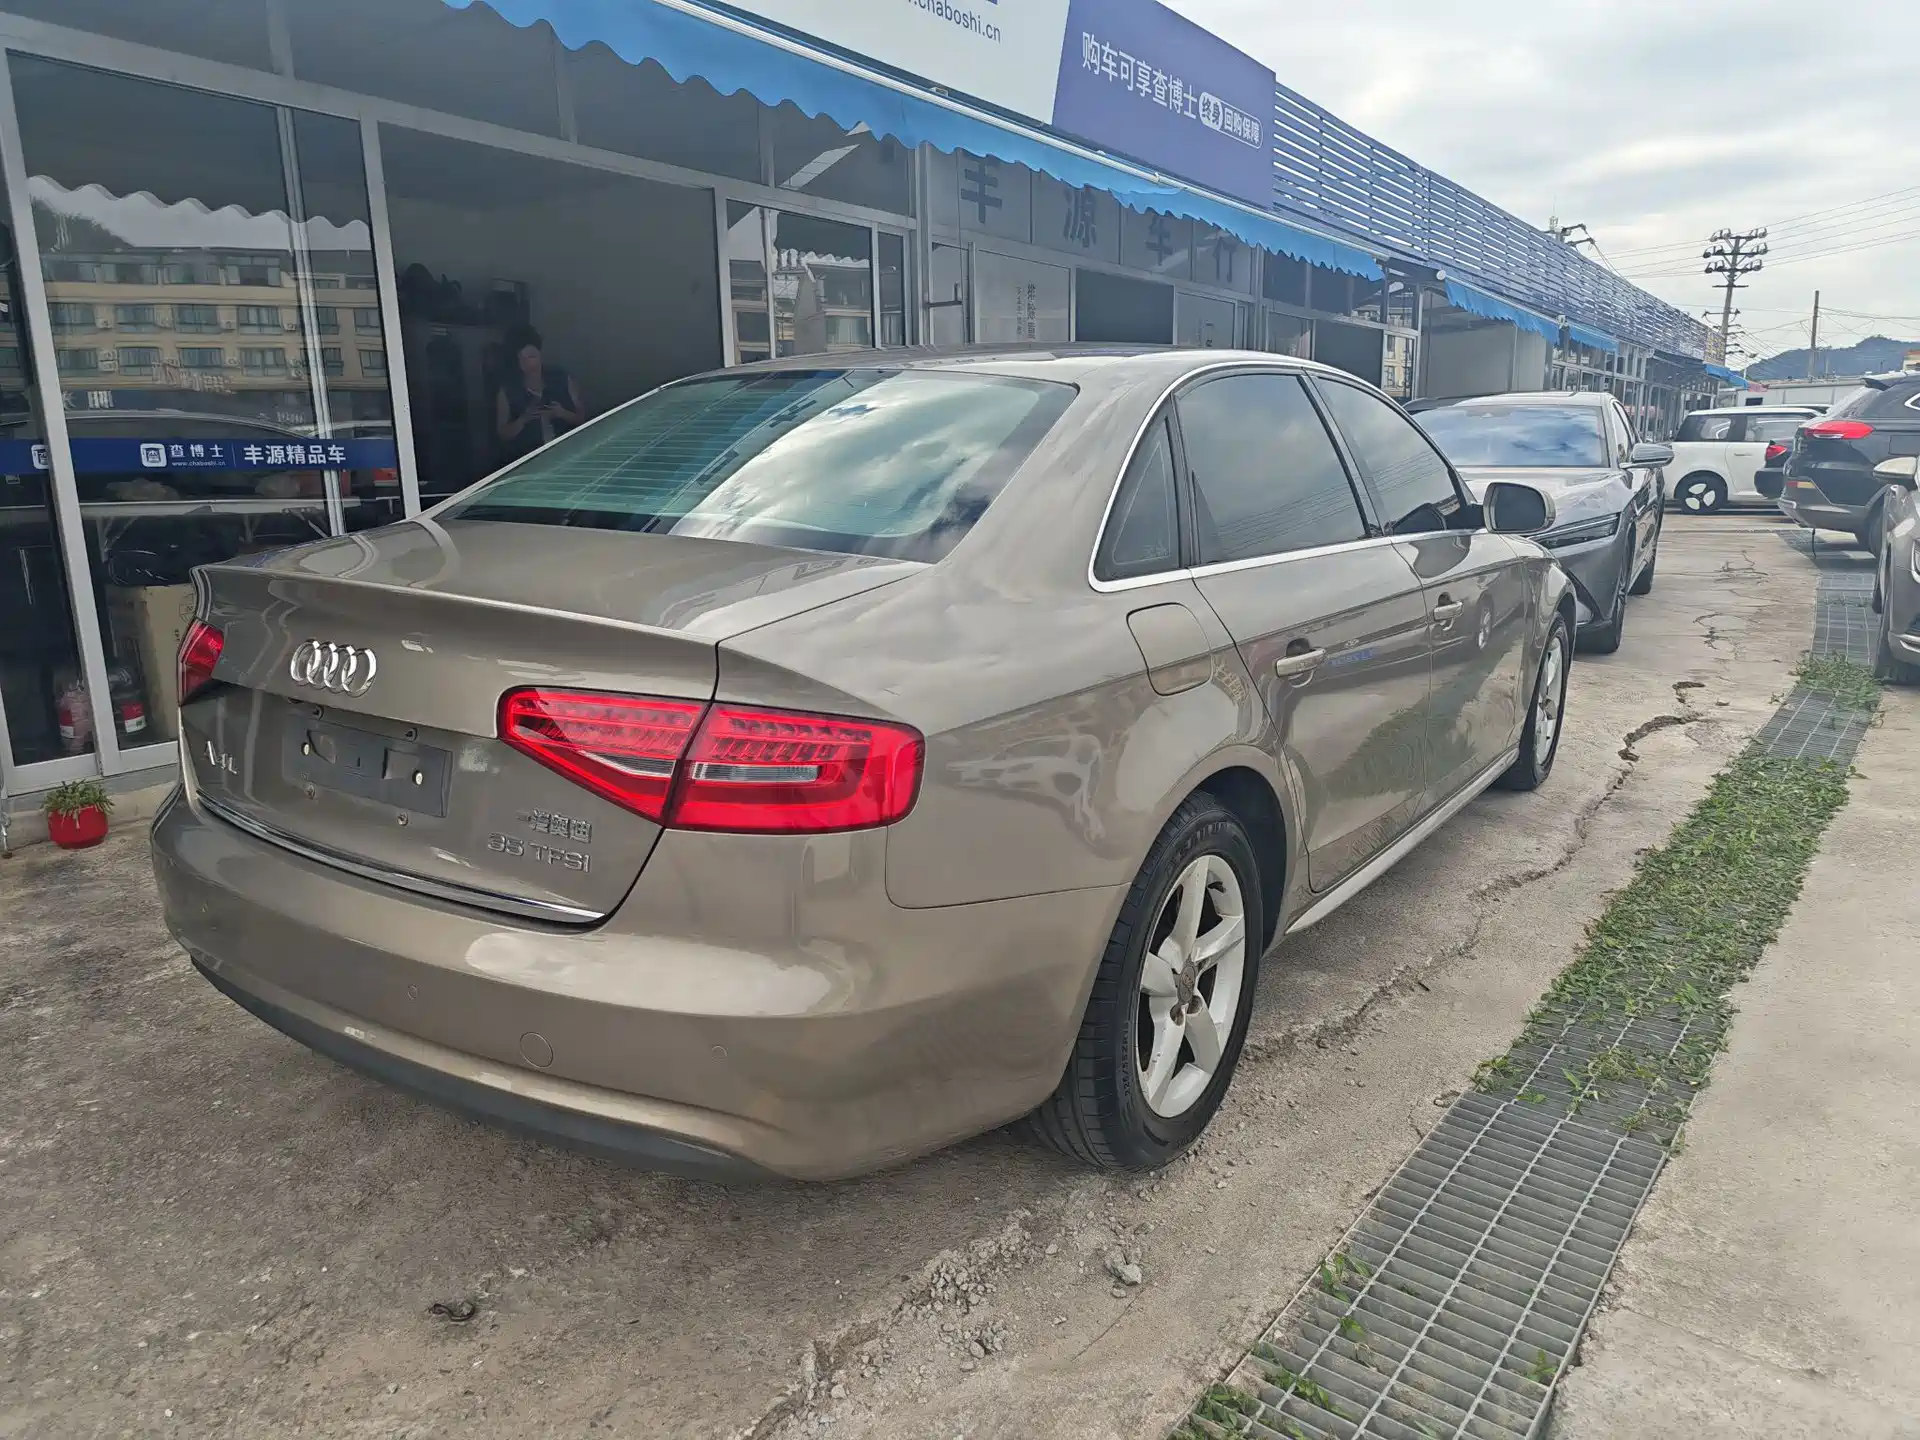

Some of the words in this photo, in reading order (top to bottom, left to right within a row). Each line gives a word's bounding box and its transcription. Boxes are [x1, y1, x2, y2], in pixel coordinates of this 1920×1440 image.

[908, 0, 1001, 44] .chaboshi.cn
[1082, 31, 1198, 120] 购车可享查博士
[170, 444, 224, 459] 查博士
[244, 444, 346, 465] 丰源精品车
[488, 833, 524, 857] 35
[528, 841, 590, 873] TFSI
